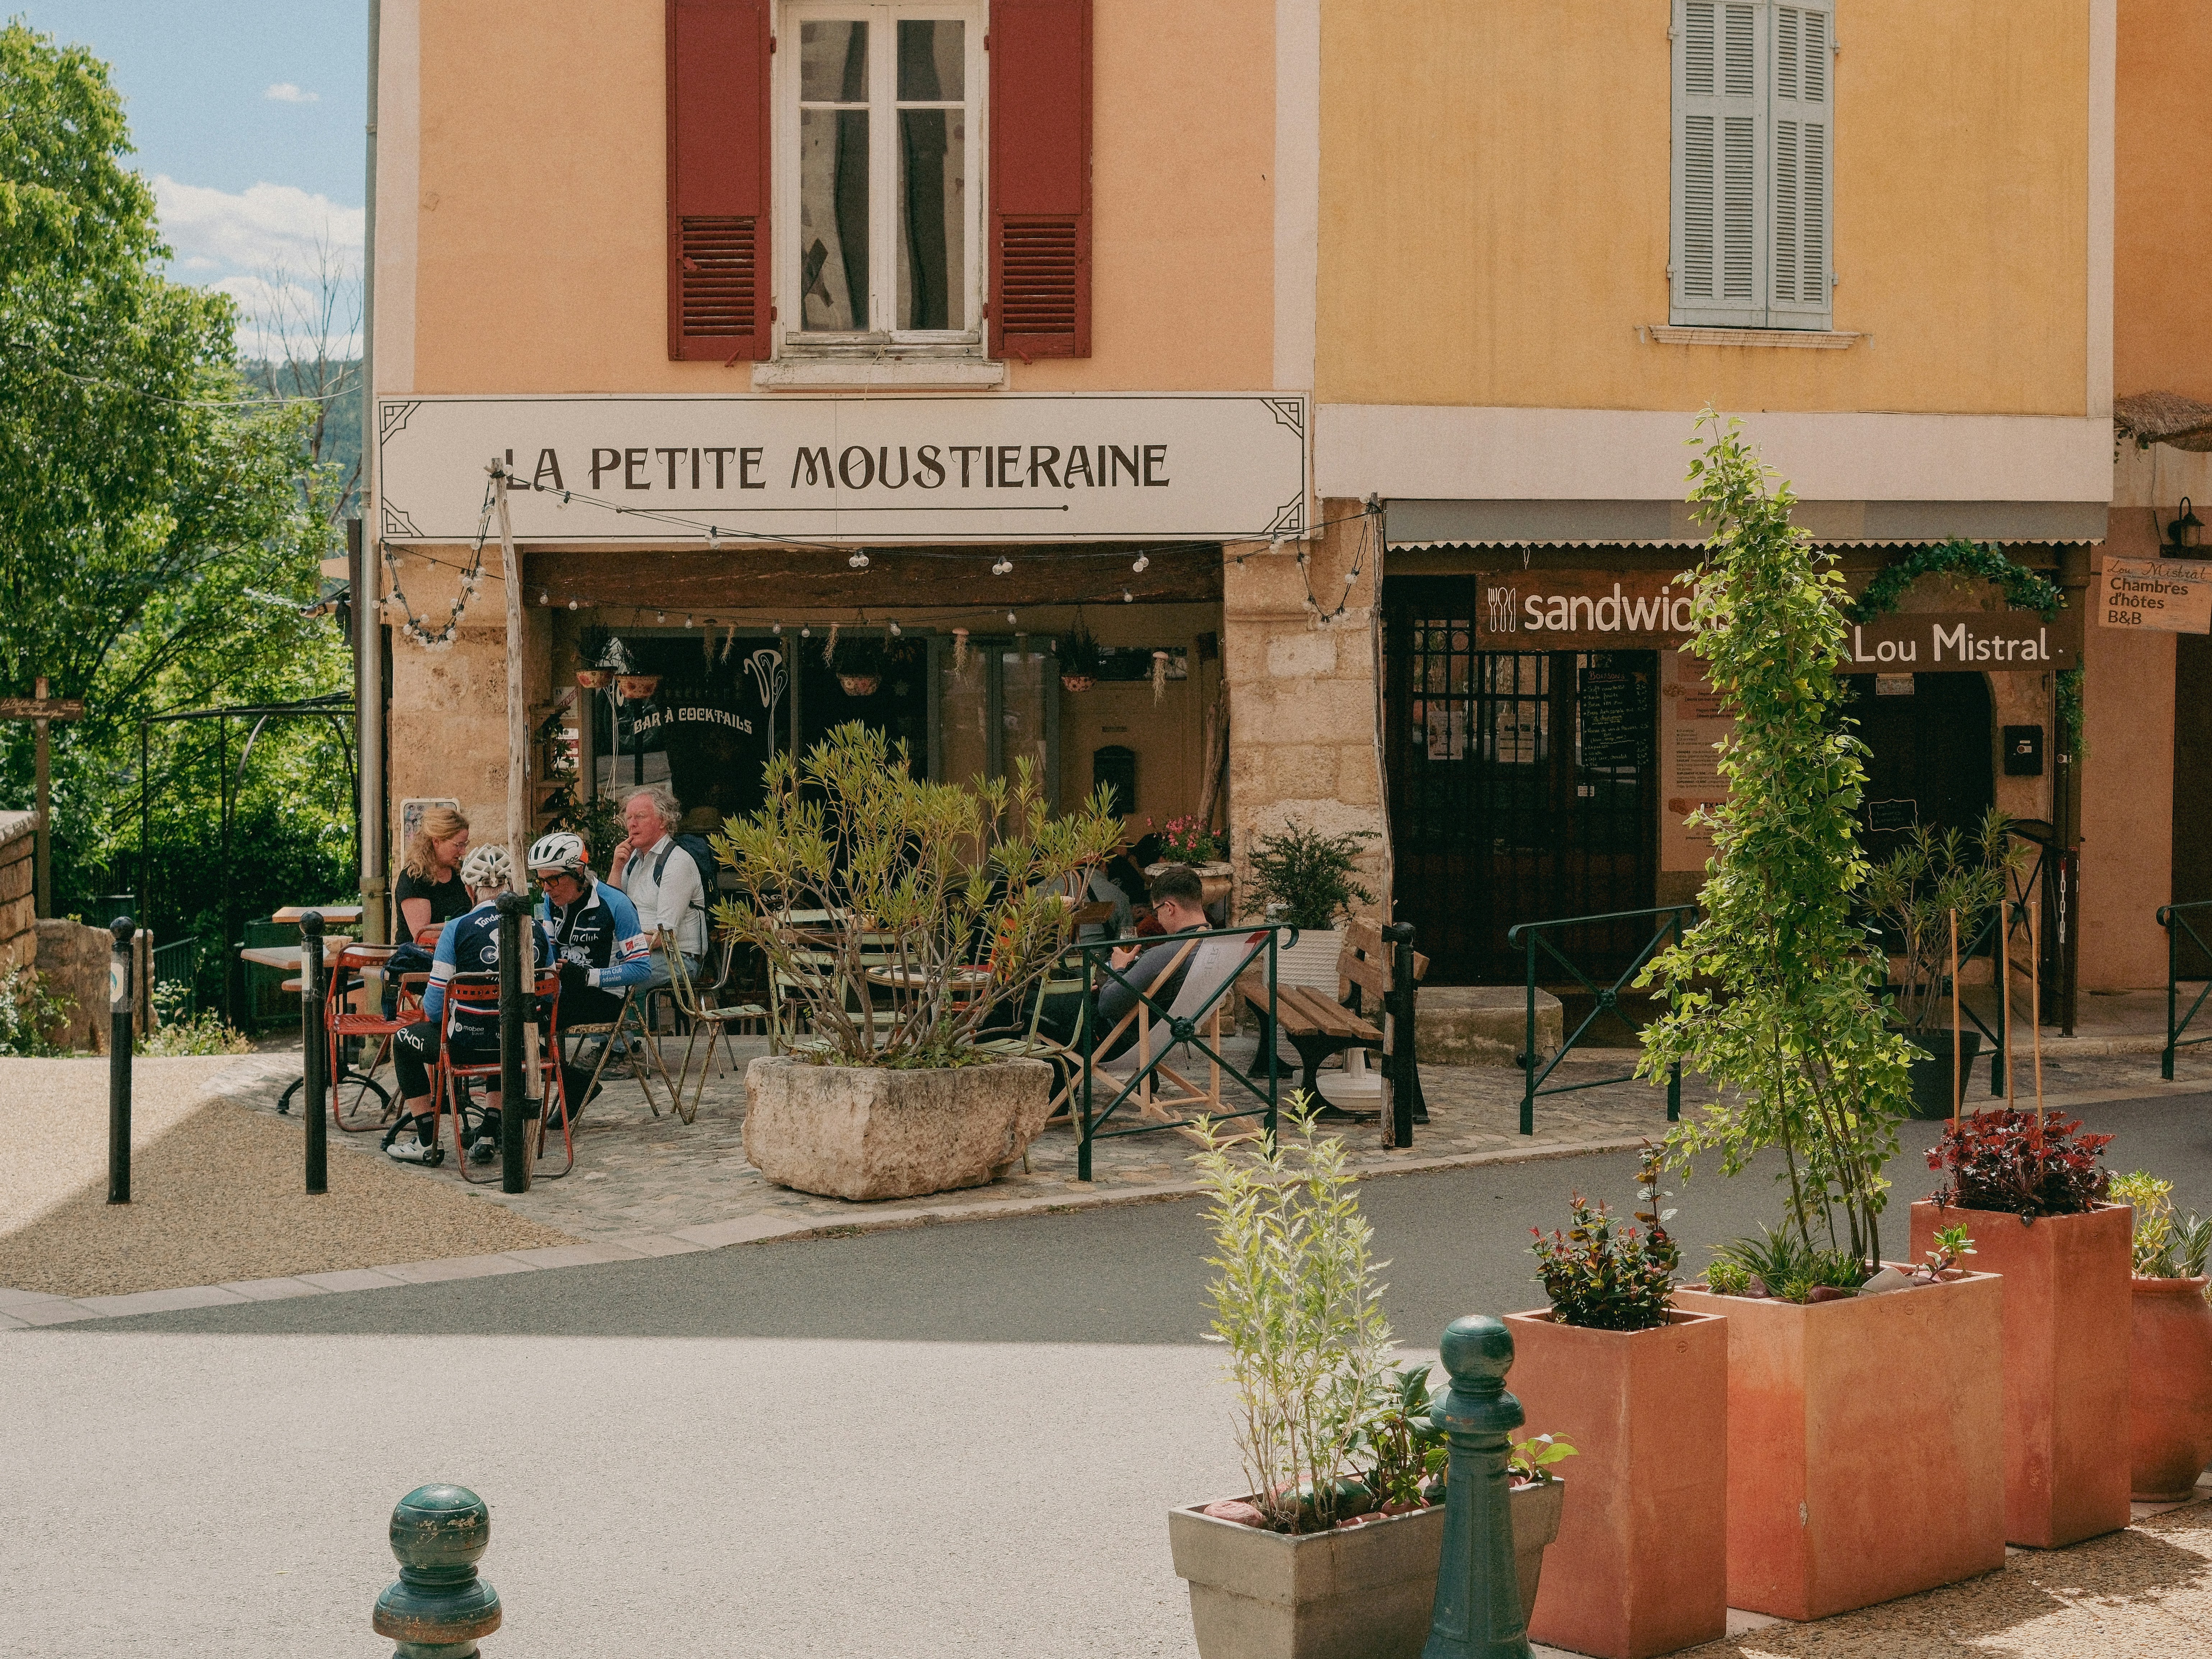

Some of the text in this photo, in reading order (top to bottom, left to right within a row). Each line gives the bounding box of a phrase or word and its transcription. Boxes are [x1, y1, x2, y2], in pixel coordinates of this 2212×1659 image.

[505, 444, 1170, 491] LA PETITE MOUSTIERAINE
[2107, 560, 2206, 580] Lou Mistral
[2110, 577, 2189, 595] Chambres
[2109, 592, 2165, 609] d'hôtes
[2108, 610, 2142, 625] B&B
[1855, 623, 2050, 662] Lou Mistral
[633, 706, 752, 735] BAR À COCKTAILS
